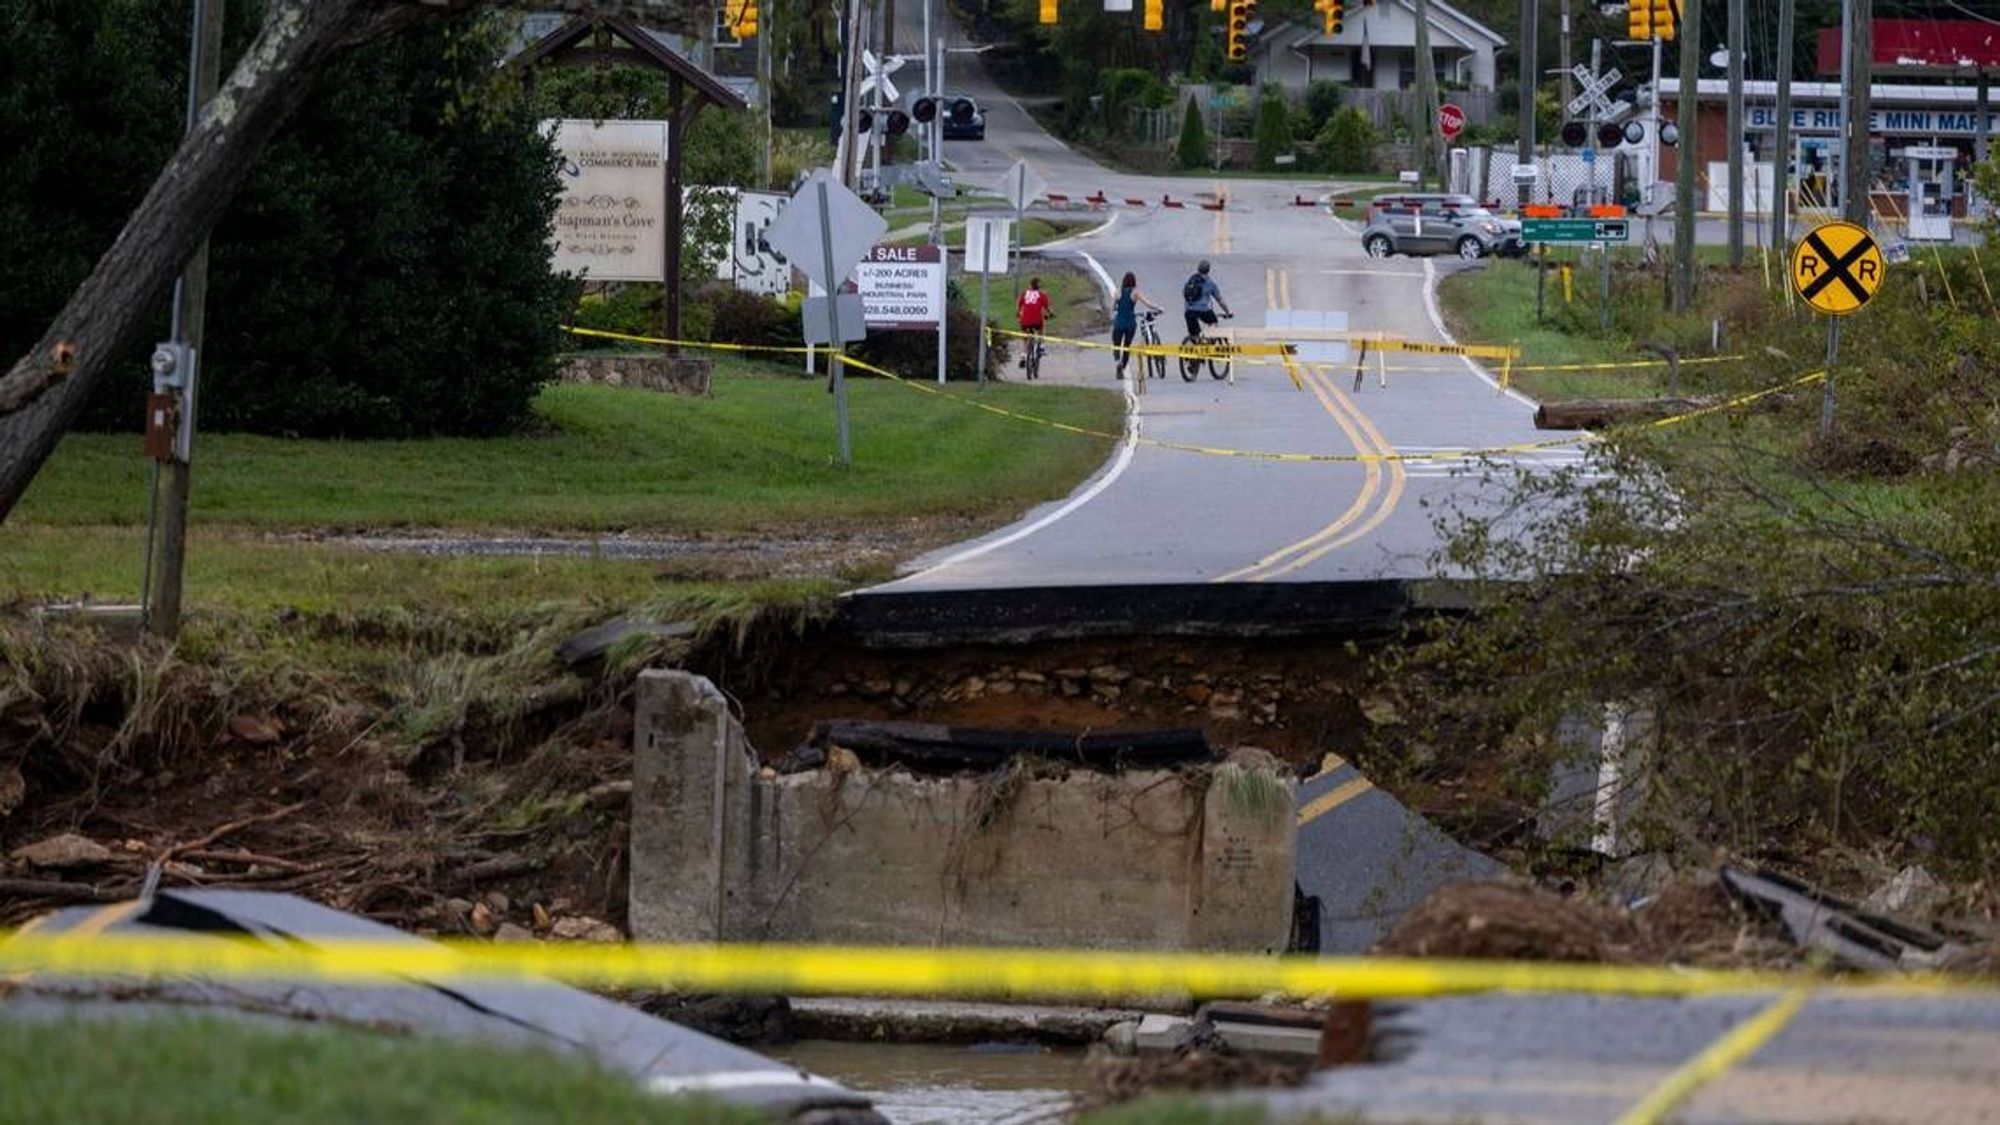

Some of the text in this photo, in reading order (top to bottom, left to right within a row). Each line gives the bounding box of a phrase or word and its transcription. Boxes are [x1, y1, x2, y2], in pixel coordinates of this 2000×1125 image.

[1439, 111, 1463, 129] STOP
[1752, 110, 1806, 127] BLE
[1886, 112, 1931, 130] MINI
[579, 159, 659, 169] COMMERCE PARK
[623, 213, 656, 228] Cove
[877, 247, 917, 261] SALE
[894, 269, 928, 279] ACRES
[1801, 256, 1877, 281] R R
[907, 291, 927, 299] PARK
[1178, 345, 1210, 355] PUBLIC
[1403, 343, 1435, 353] PUBLIC
